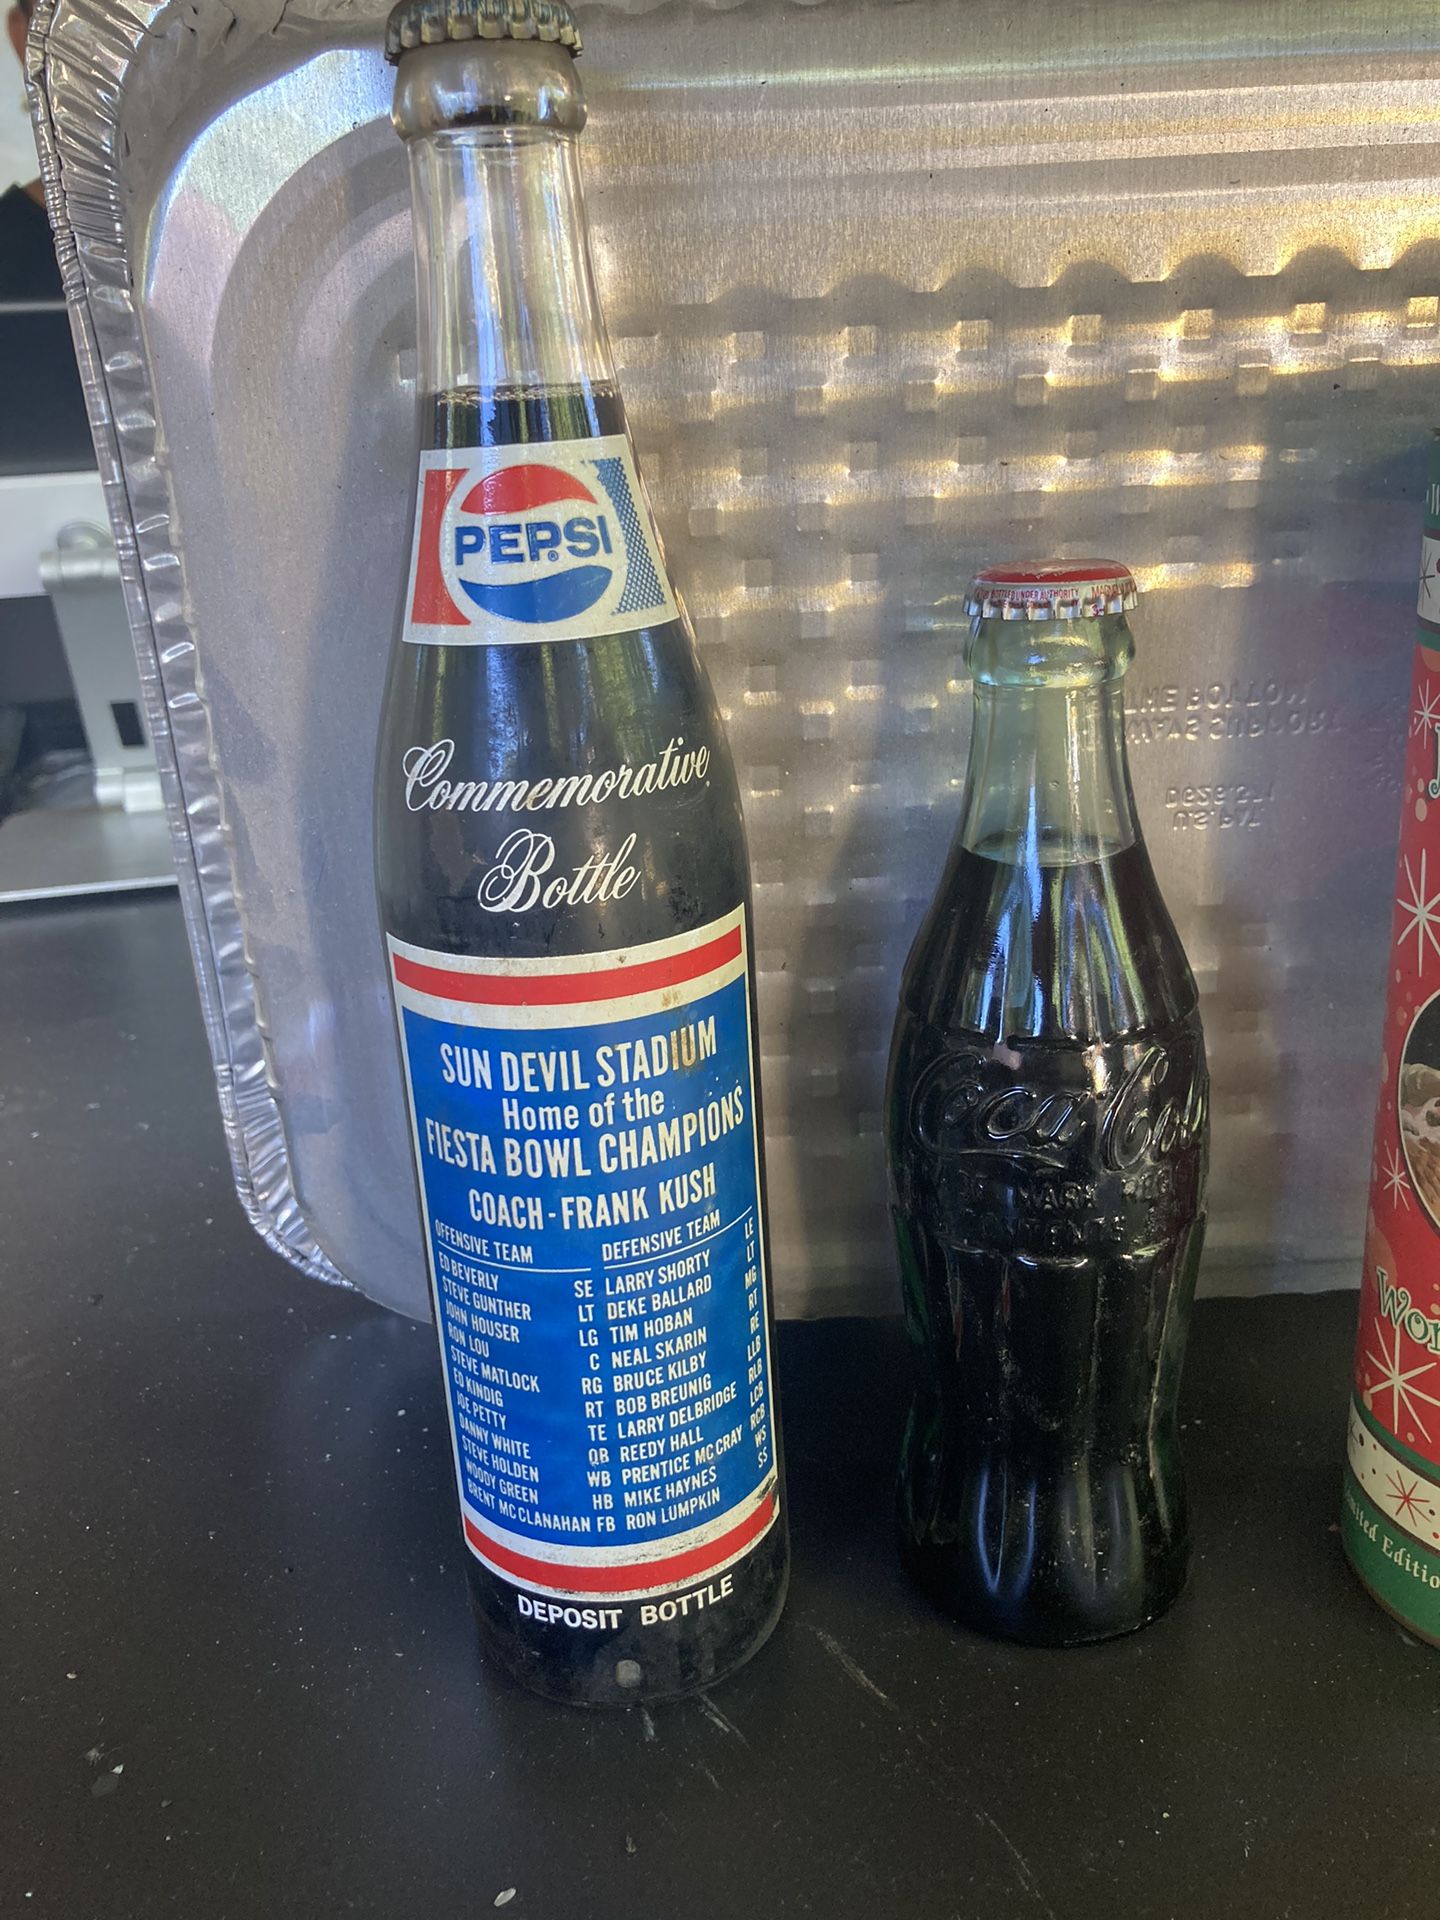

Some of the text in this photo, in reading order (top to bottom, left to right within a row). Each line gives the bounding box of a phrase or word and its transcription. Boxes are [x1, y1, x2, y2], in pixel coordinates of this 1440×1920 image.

[455, 515, 613, 566] PEPSI
[1040, 587, 1080, 601] AUTHORITY
[402, 738, 710, 812] Commemorative
[477, 828, 641, 913] Bottle
[440, 1015, 717, 1092] SUN DEVIL STADIUM
[425, 1084, 745, 1179] FIESTA BOWL CHAMPIONS
[502, 1087, 665, 1131] Home of the
[658, 1162, 716, 1215] KUSH
[435, 1219, 533, 1264] OFFENSIVE TEAM
[601, 1209, 720, 1262] DEFENSIVE TEAM
[605, 1217, 754, 1296] LARRY SHORTY LE
[438, 1251, 594, 1298] ED BEVERLY SE
[442, 1275, 595, 1323] STEVE GUNTHER LT
[607, 1240, 755, 1320] DEKE BALLARD LT
[445, 1299, 599, 1347] JOHN HOUSER LG
[609, 1265, 757, 1344] TIM HOBAN MG
[611, 1287, 758, 1369] NEAL SKARIN RT
[448, 1321, 600, 1370] RON LOU C
[450, 1345, 603, 1395] STEVE MATLOCK RG
[613, 1310, 760, 1393] BRUCE KILBY RE
[453, 1367, 604, 1418] ED KINDIG RT
[615, 1335, 761, 1416] BOB BREUNIG LLB
[617, 1357, 763, 1439] LARRY DELBRIDGE RLB
[456, 1390, 608, 1442] JOE PETTY TE
[459, 1412, 610, 1466] DANNY WHITE QB
[620, 1381, 764, 1463] REEDY HALL LCB
[461, 1435, 612, 1487] STEVE HOLDEN WB
[621, 1453, 691, 1486] PRENTICE
[750, 1403, 765, 1431] RCB
[624, 1424, 767, 1508] MIKE HAYNES WS
[464, 1457, 614, 1511] WOODY GREEN HB
[467, 1478, 495, 1510] BRENT
[596, 1516, 616, 1533] FB
[626, 1446, 768, 1531] RON LUMPKIN SS
[517, 1574, 734, 1630] DEPOSIT BOTTLE
